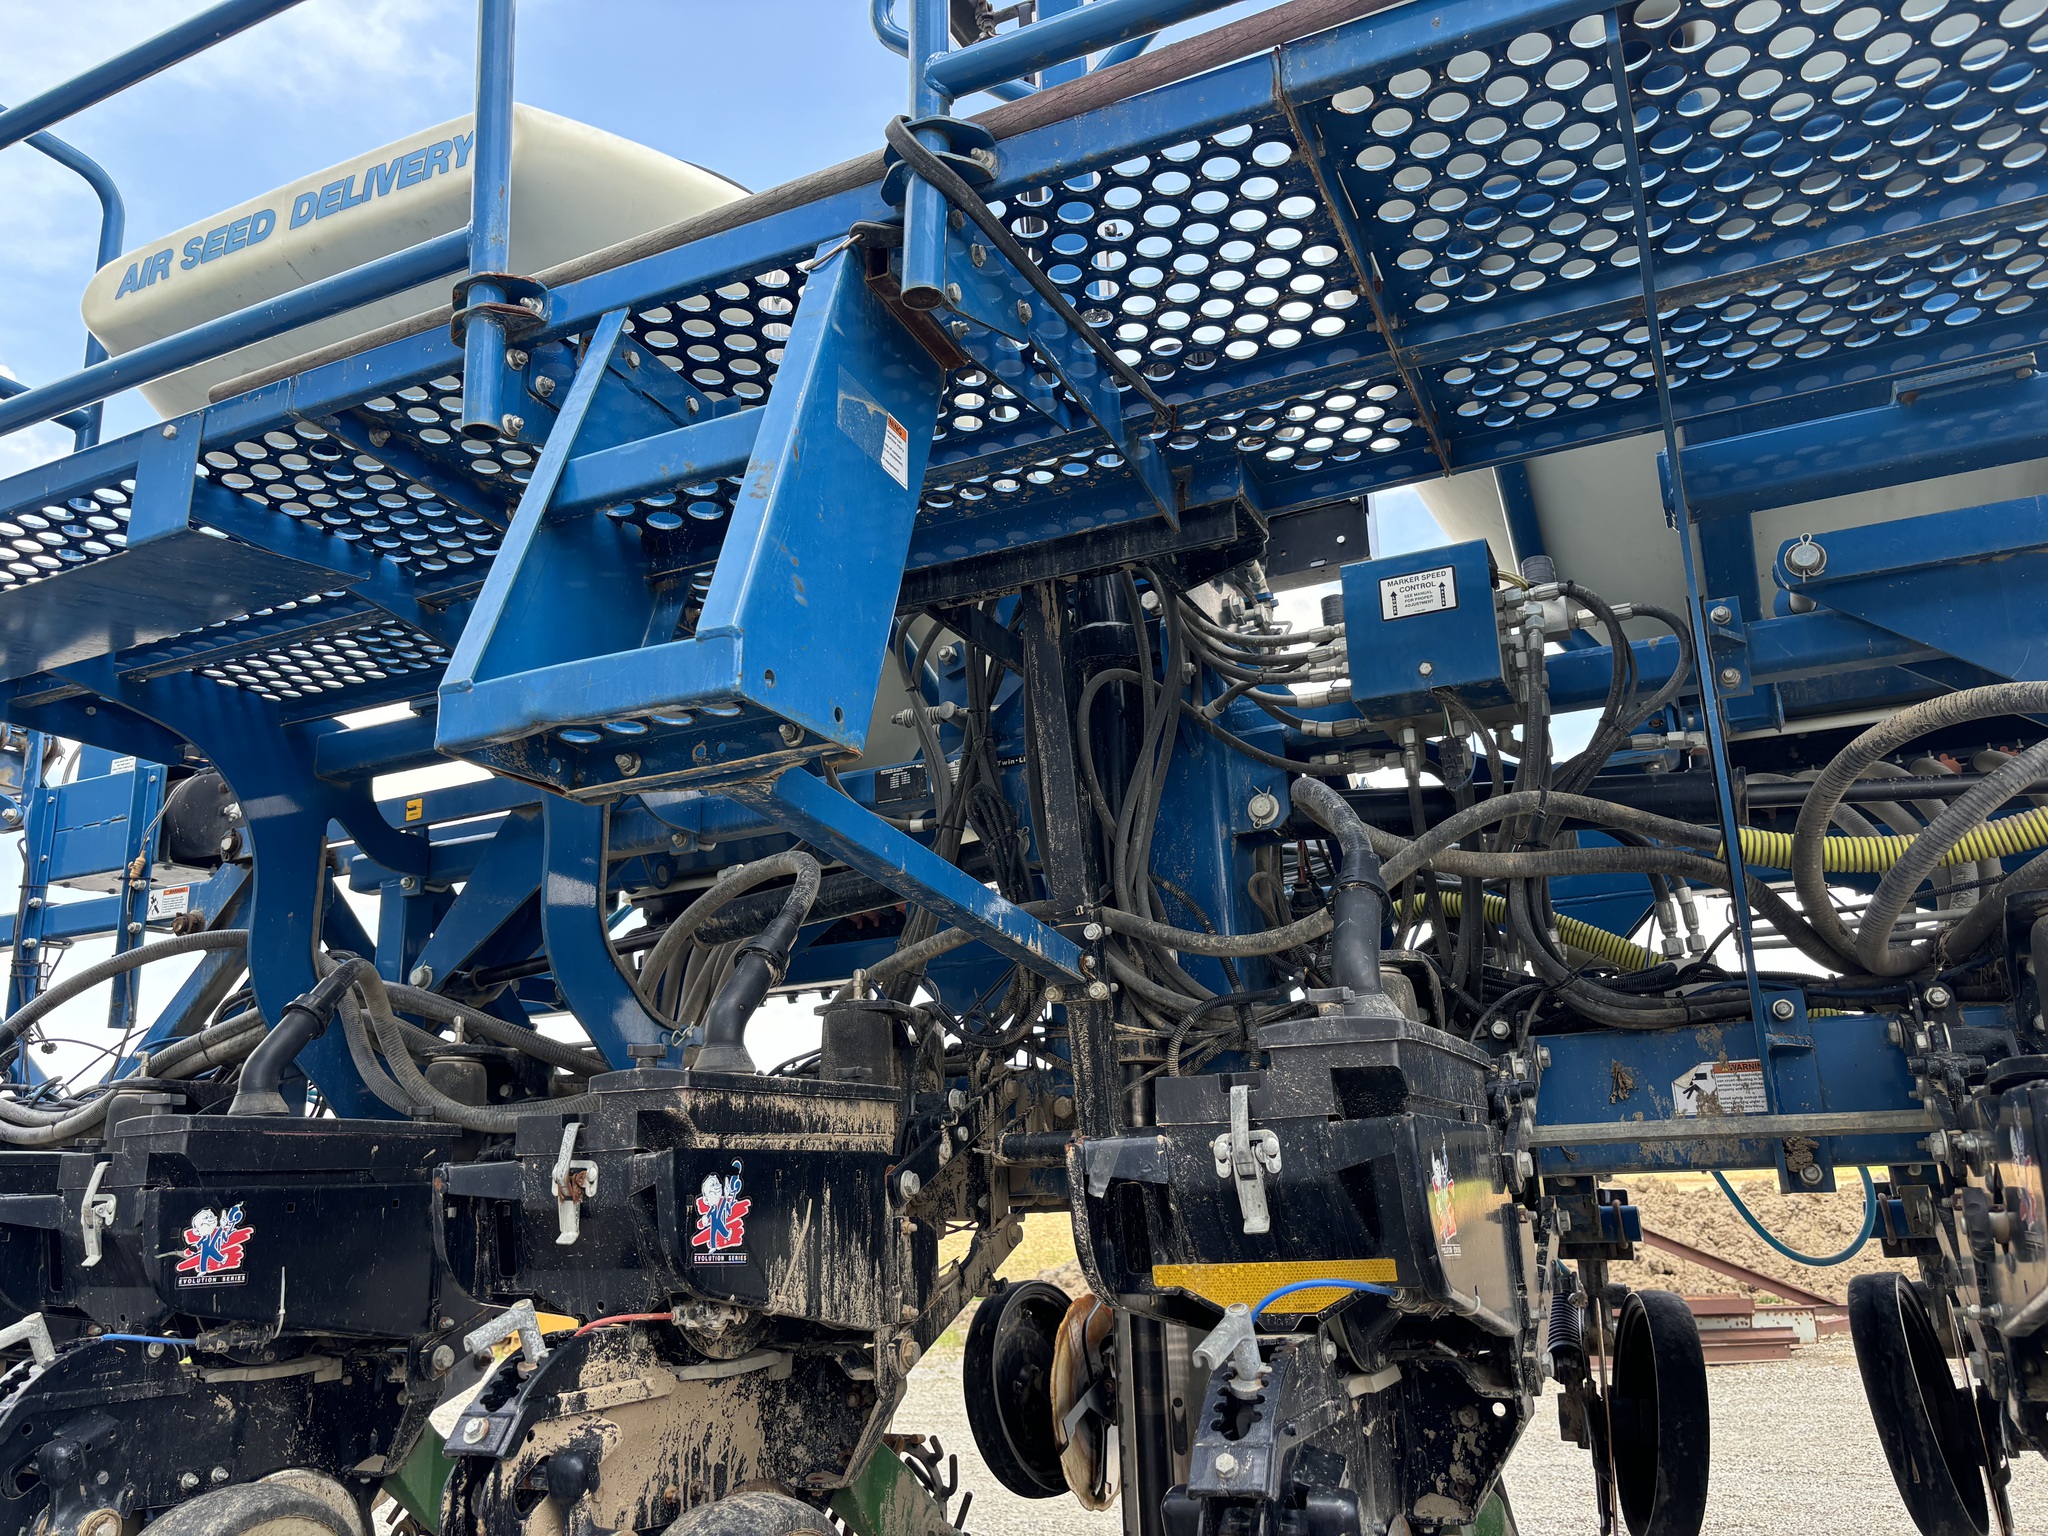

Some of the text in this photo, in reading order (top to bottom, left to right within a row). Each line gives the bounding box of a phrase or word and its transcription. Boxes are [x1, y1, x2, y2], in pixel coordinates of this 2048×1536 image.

[115, 130, 473, 300] AIR SEED DELIVERY
[1387, 571, 1447, 587] MARKER SPEED
[1399, 581, 1436, 593] CONTROL
[1405, 599, 1434, 608] ADJUSTMENT
[1728, 1063, 1761, 1071] WARNIN
[178, 1277, 217, 1285] EVOLUTION
